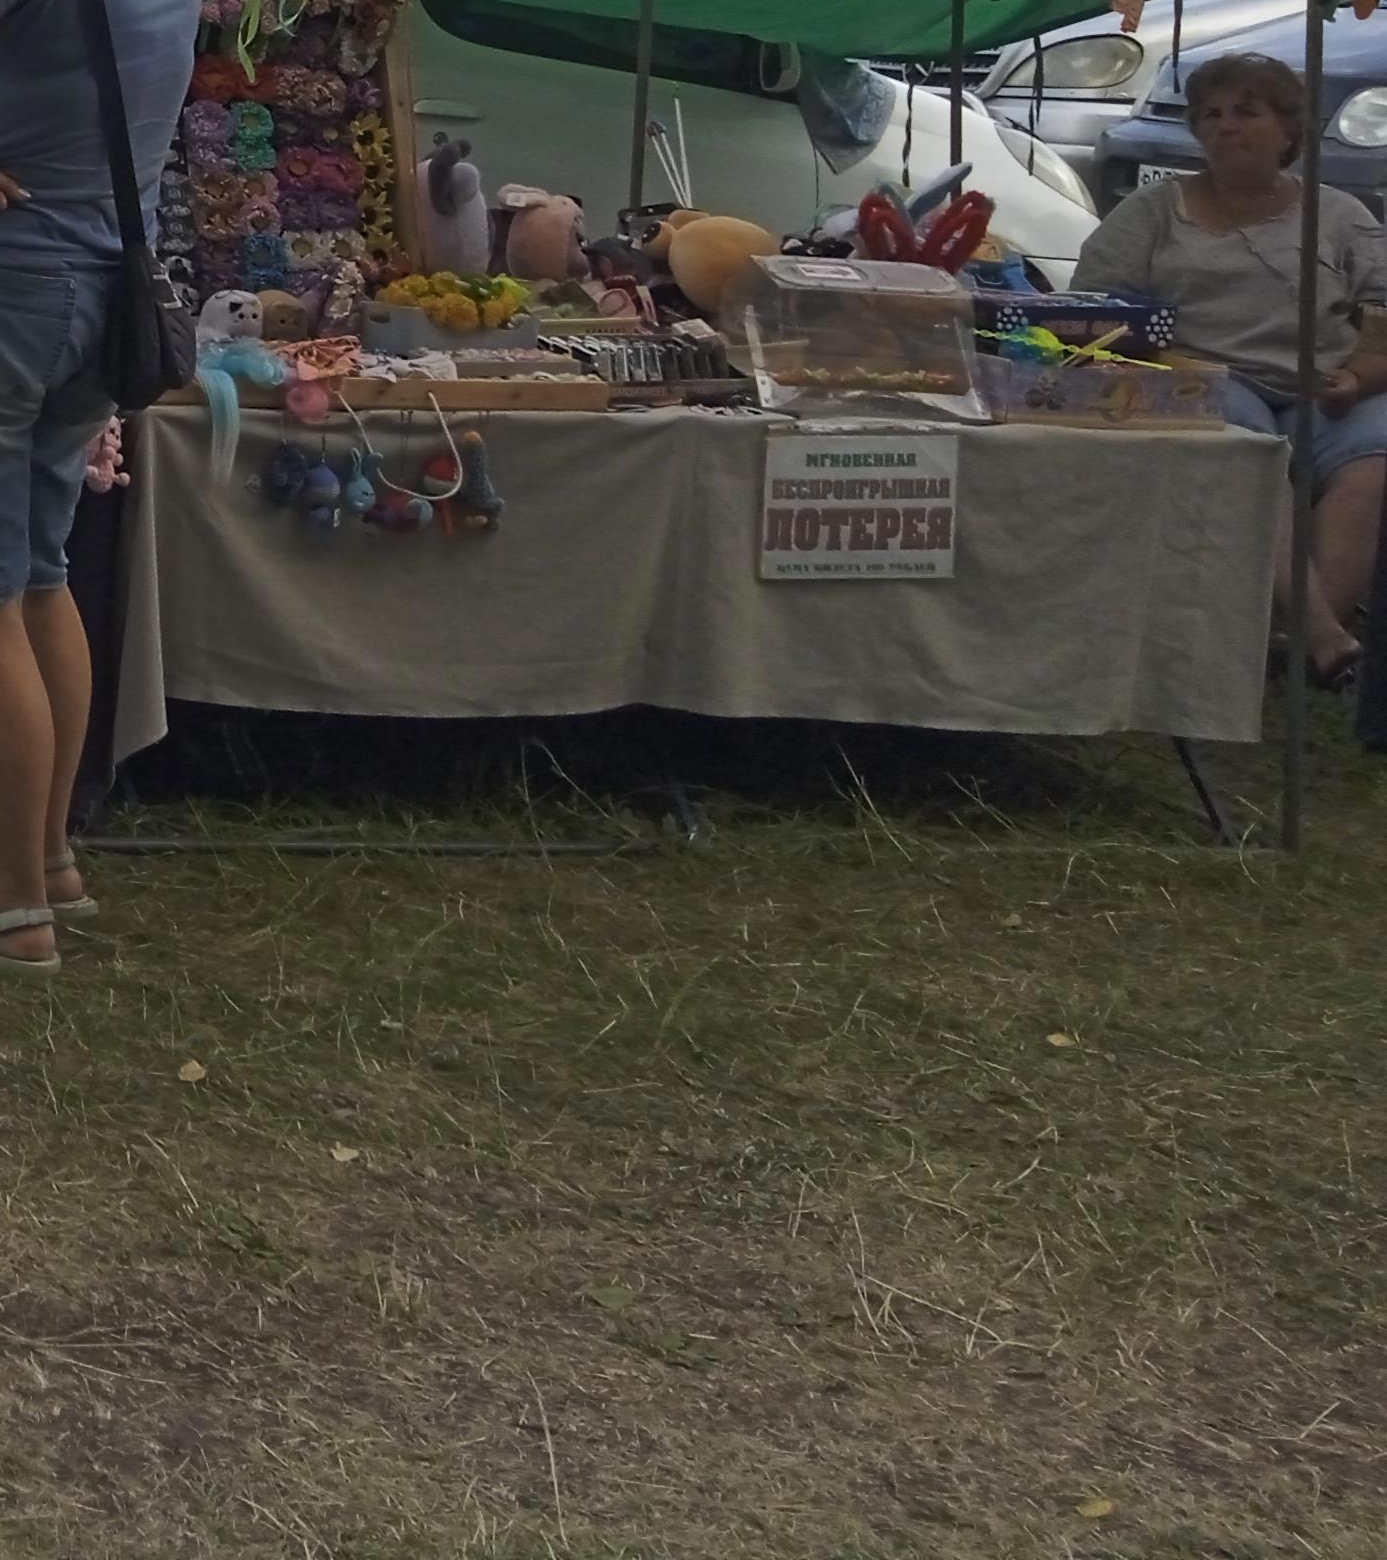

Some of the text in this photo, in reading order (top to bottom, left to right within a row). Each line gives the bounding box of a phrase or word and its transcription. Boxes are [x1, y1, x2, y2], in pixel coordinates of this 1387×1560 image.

[805, 453, 917, 468] МГНОВЕННАЯ
[771, 478, 951, 500] БЕСПРОИГРЫШНАЯ
[764, 507, 954, 551] ЛОТЕРЕЯ
